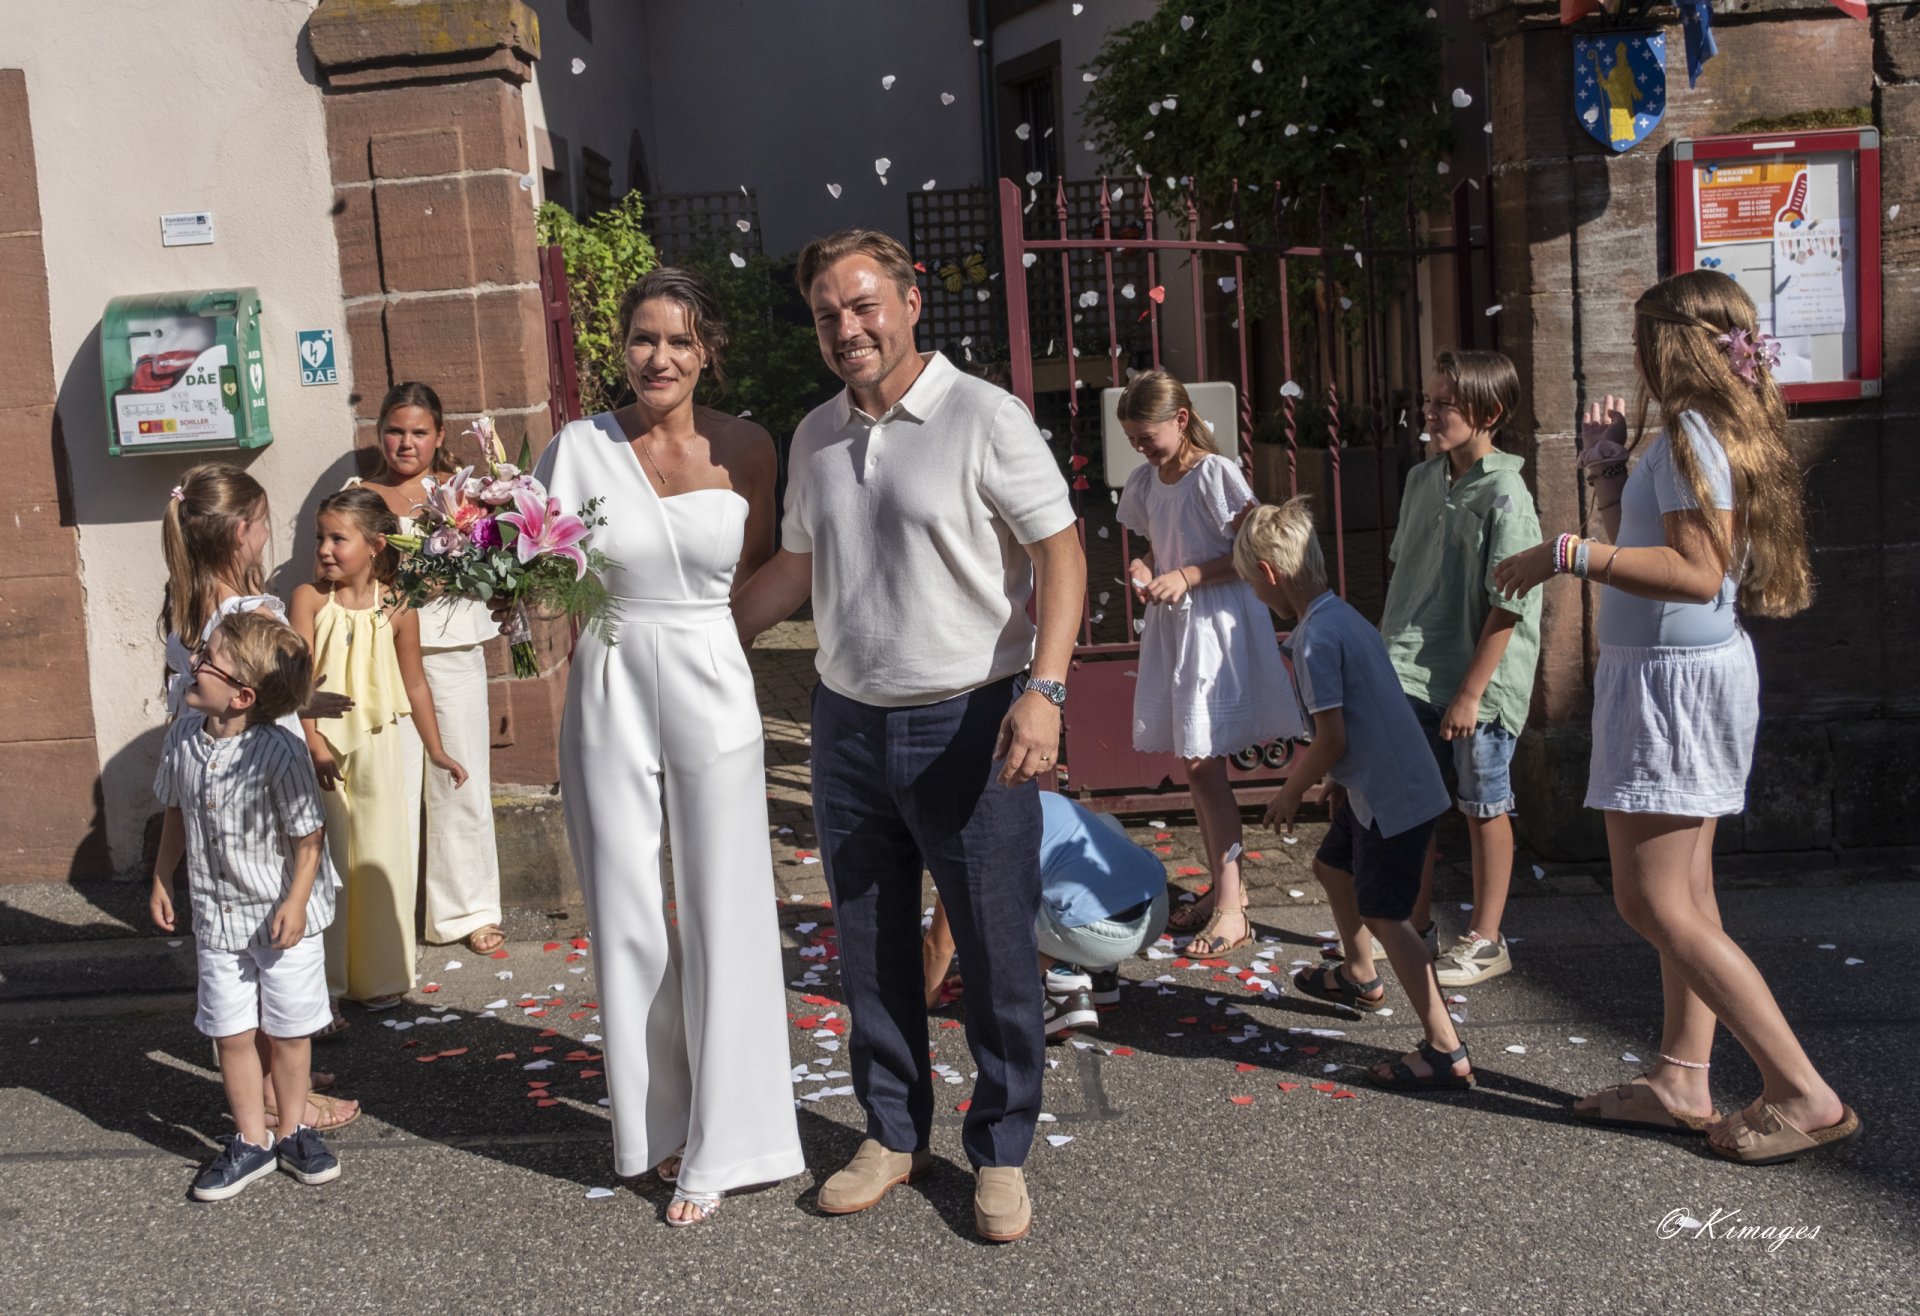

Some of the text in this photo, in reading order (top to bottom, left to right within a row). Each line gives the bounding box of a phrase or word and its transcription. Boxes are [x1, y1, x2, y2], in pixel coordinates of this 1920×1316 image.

[248, 350, 261, 360] AED
[185, 373, 217, 387] DAE
[303, 369, 337, 384] DAE
[252, 398, 266, 408] DAE
[180, 418, 209, 426] SCHILLER
